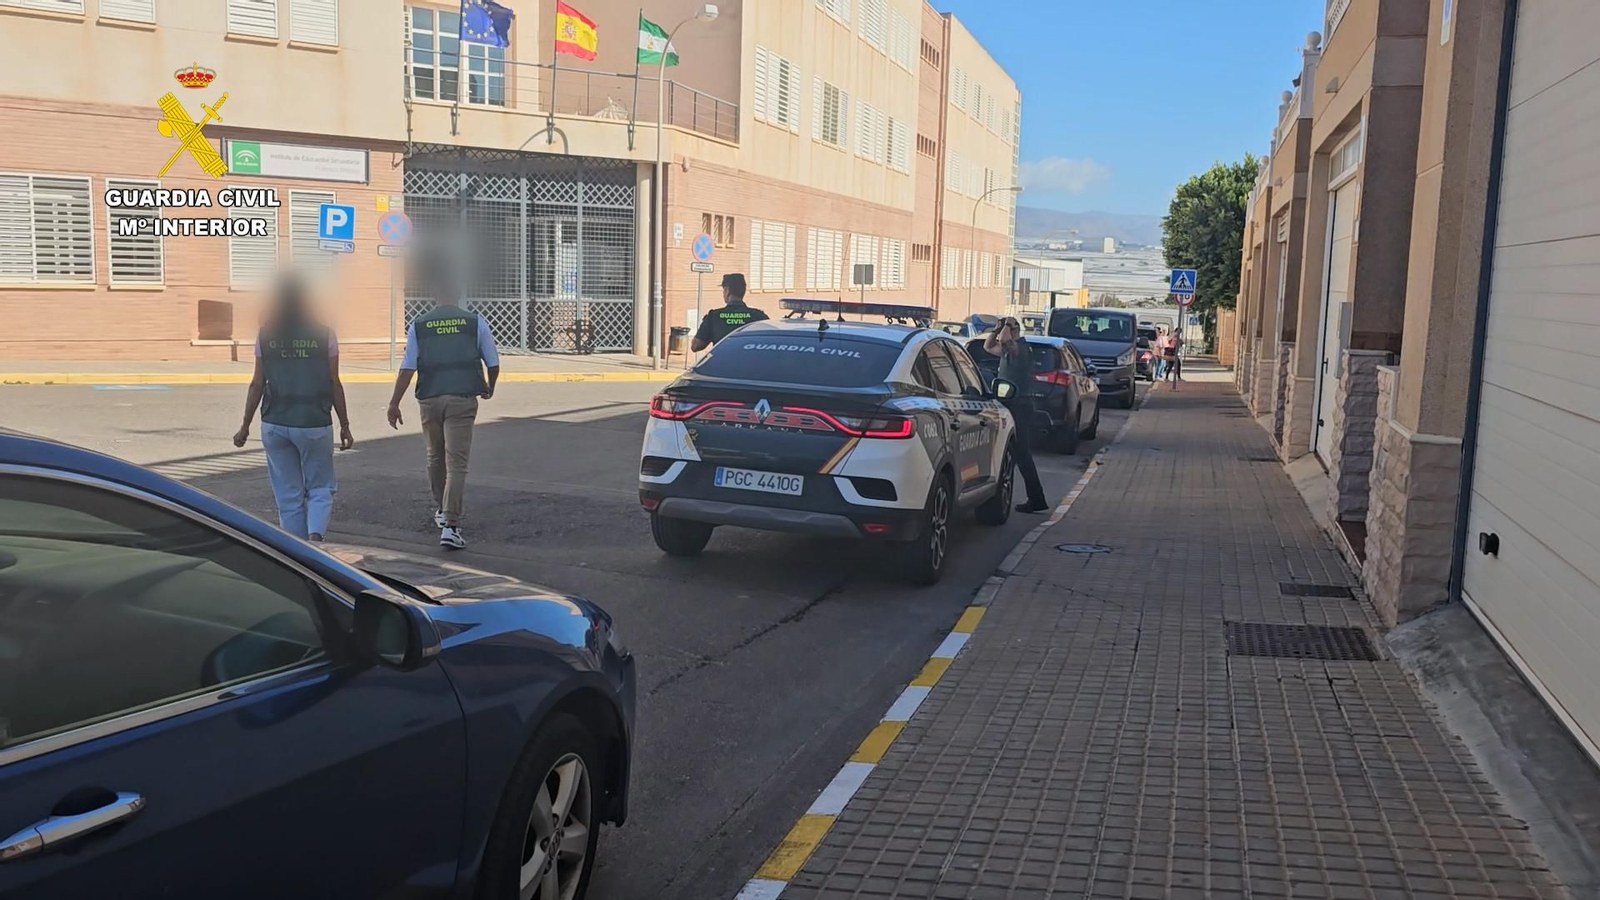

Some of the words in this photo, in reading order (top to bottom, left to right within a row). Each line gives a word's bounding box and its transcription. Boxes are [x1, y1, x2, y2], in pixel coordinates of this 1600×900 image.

[326, 208, 348, 236] P
[426, 318, 467, 328] GUARDIA
[436, 326, 460, 335] CIVIL
[743, 344, 815, 353] GUARDIA
[820, 348, 861, 358] CIVIL
[725, 470, 754, 487] PGC
[757, 475, 800, 492] 4410G
